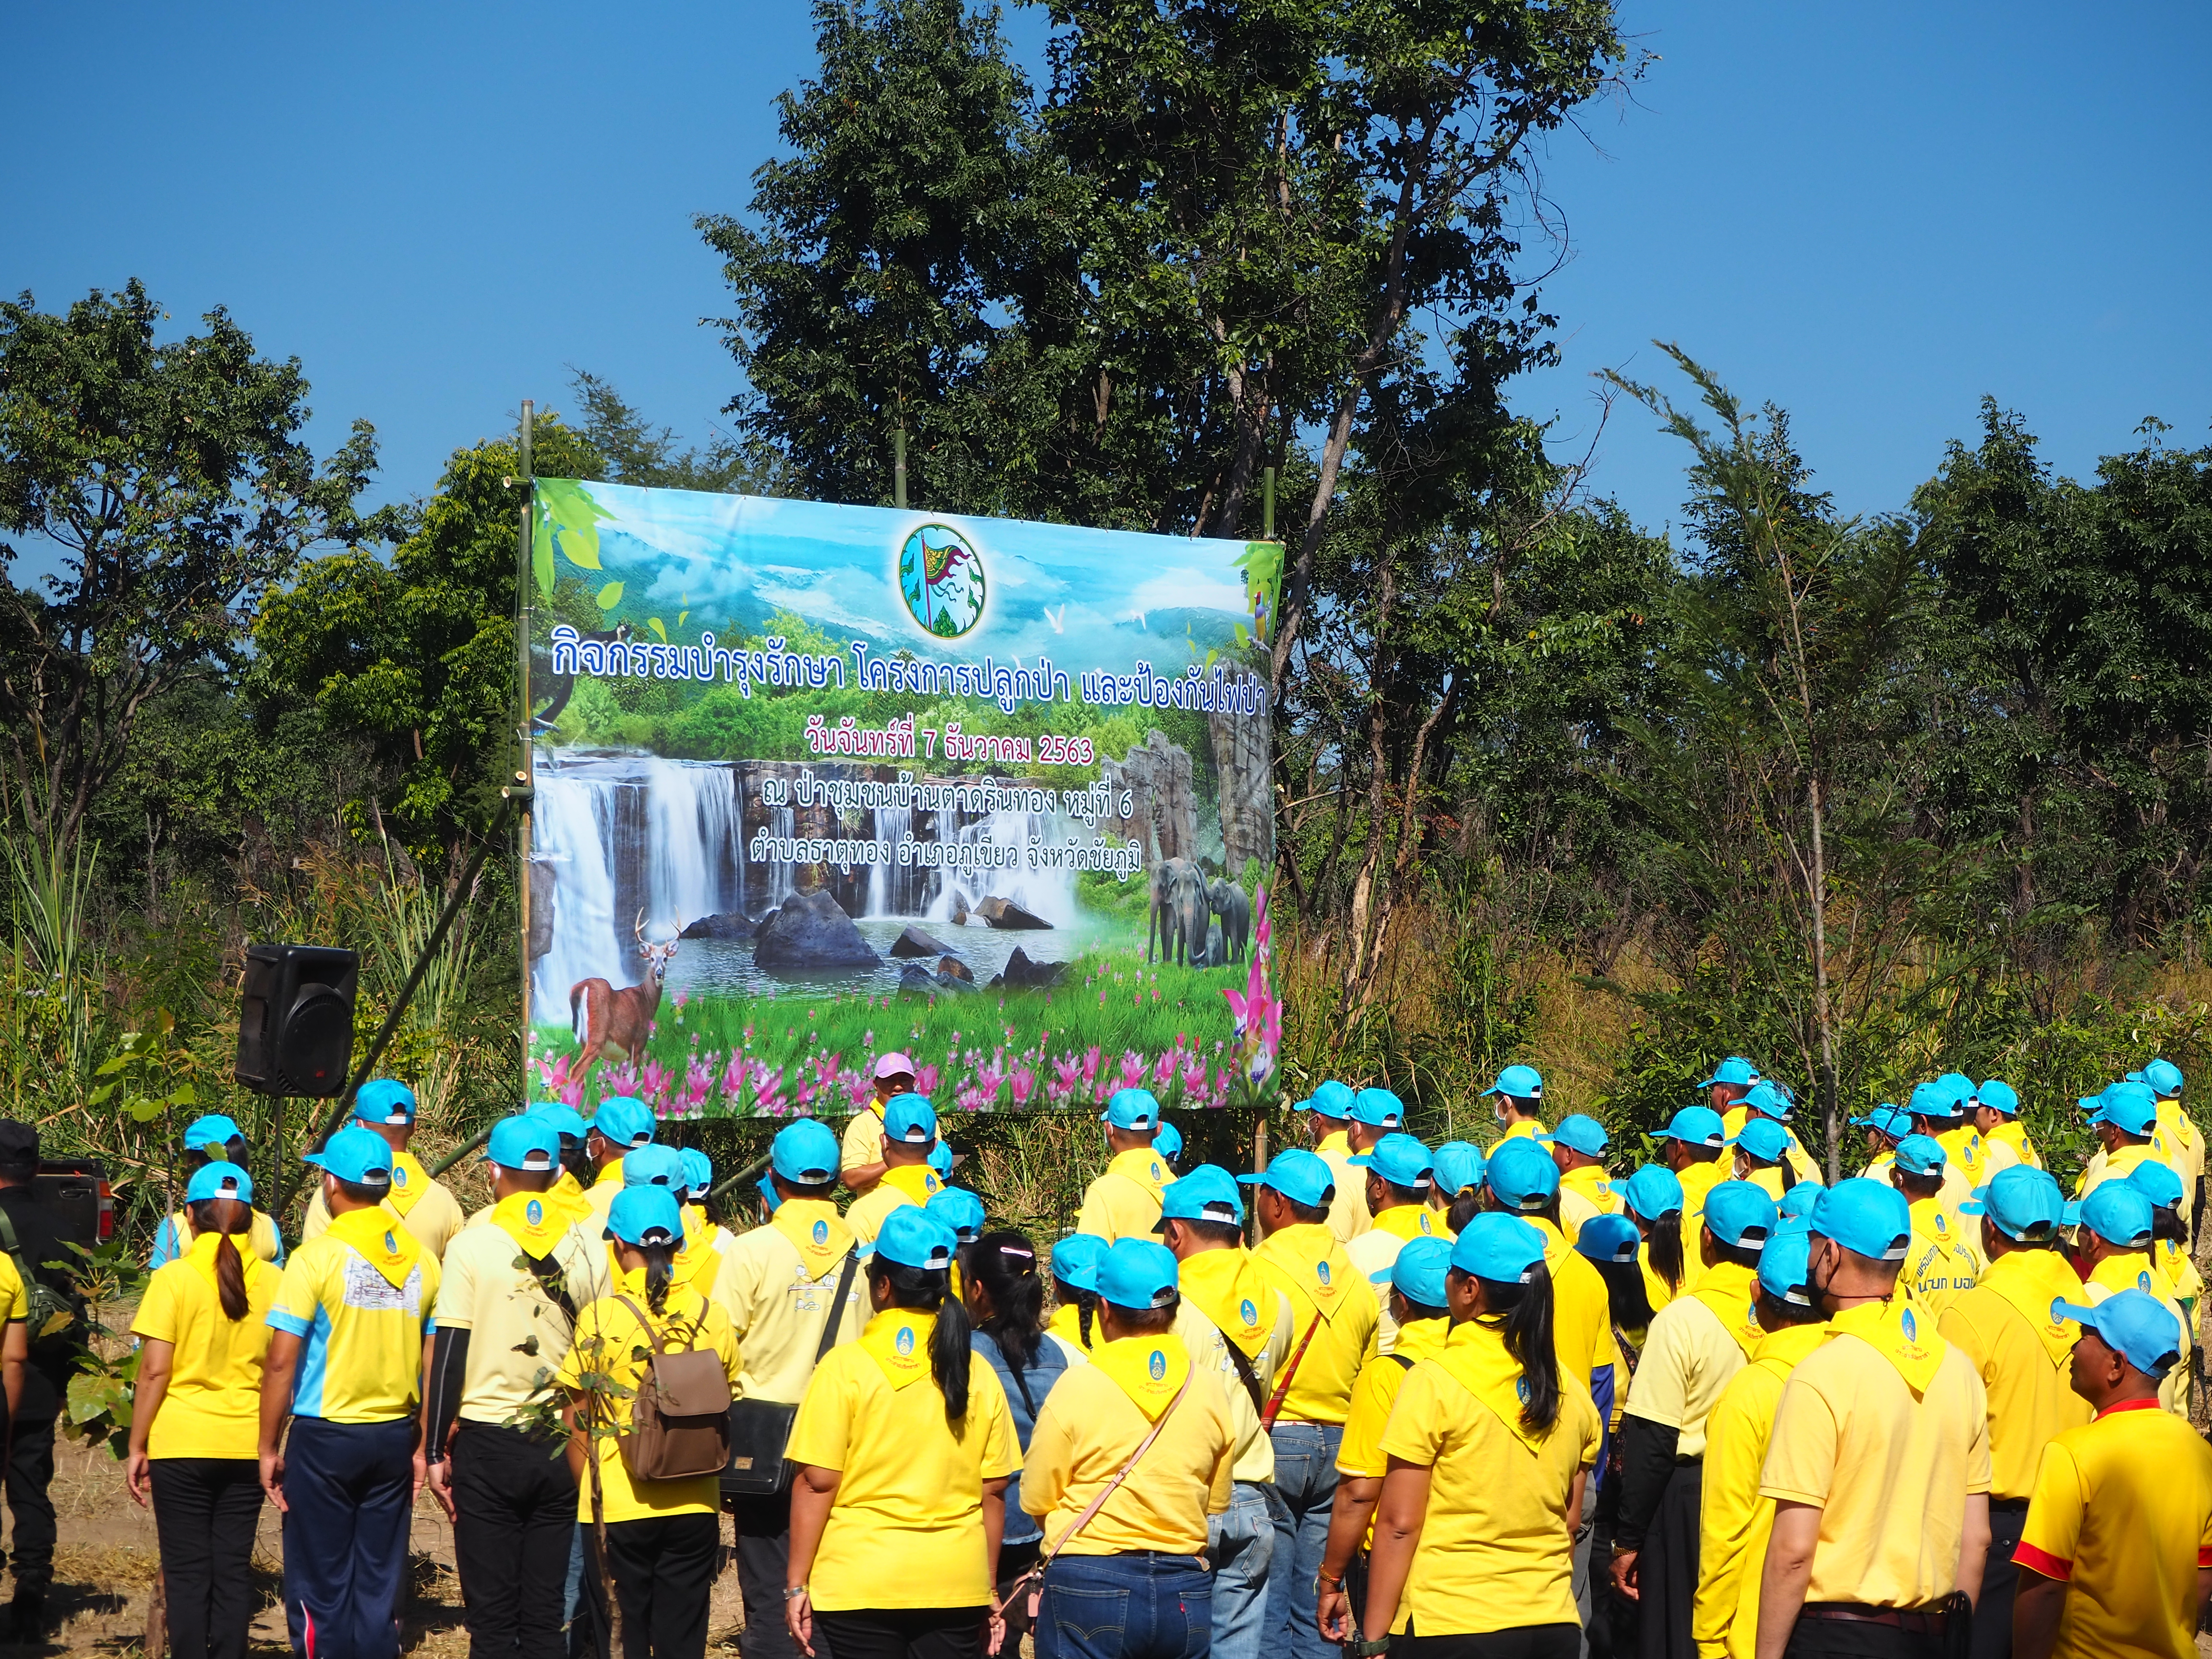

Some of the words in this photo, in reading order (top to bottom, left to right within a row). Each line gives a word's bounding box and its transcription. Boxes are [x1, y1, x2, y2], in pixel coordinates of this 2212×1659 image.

[551, 625, 844, 698] กิจกรรมบำรุงรักษา
[852, 641, 1070, 715] โครงการปลูกป่า
[1082, 658, 1266, 716] และป้องกันไฟป่า
[805, 712, 916, 758] วันจันทร์ที่
[923, 729, 937, 759] 7
[944, 722, 1032, 763] ธันวาคม
[1040, 735, 1094, 766] 2563
[762, 777, 788, 806] ณ
[1064, 770, 1113, 829] หมู่ที่
[1119, 791, 1134, 820] 6
[750, 826, 890, 875] ตำบลธาตุทอง
[898, 831, 1018, 878] อำเภอภูเขียว
[1026, 836, 1143, 883] จังหวัดชัยภูมิ
